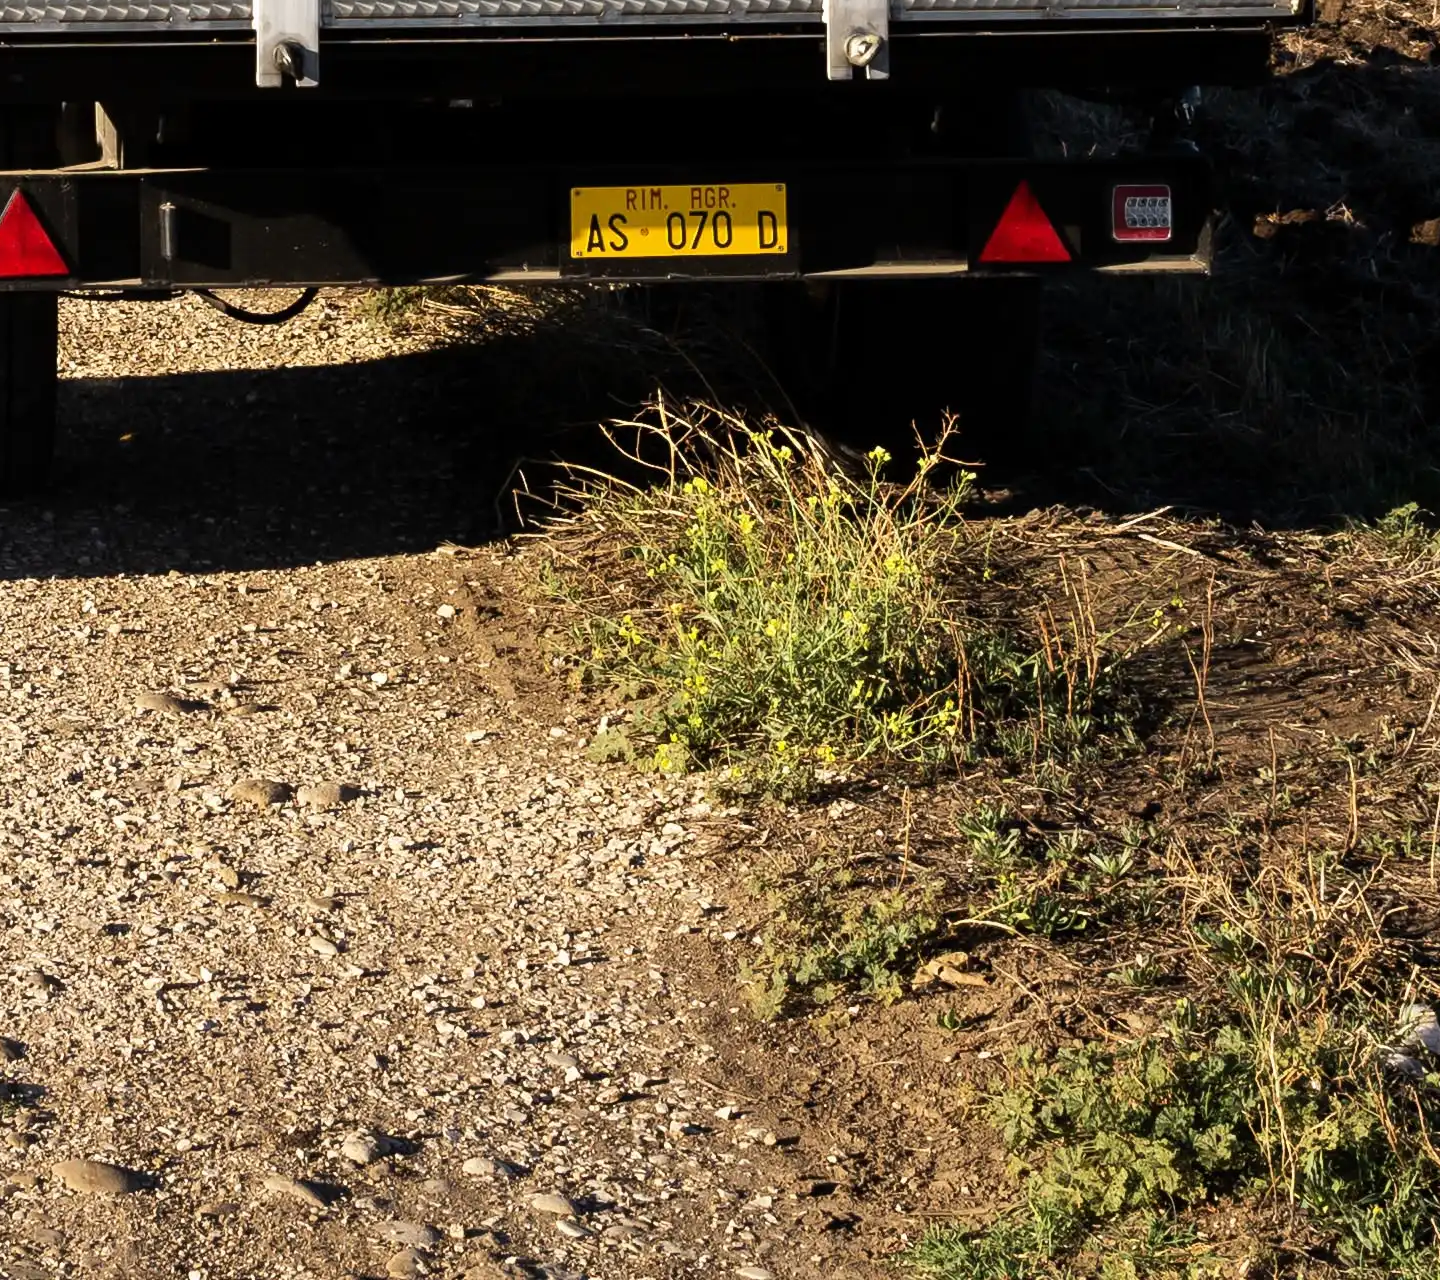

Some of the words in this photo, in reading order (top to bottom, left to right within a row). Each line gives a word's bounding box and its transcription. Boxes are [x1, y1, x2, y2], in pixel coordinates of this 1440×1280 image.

[626, 188, 669, 210] RIM.
[691, 187, 737, 209] AGR.
[587, 213, 629, 252] AS
[667, 210, 733, 250] 070
[757, 210, 778, 249] D
